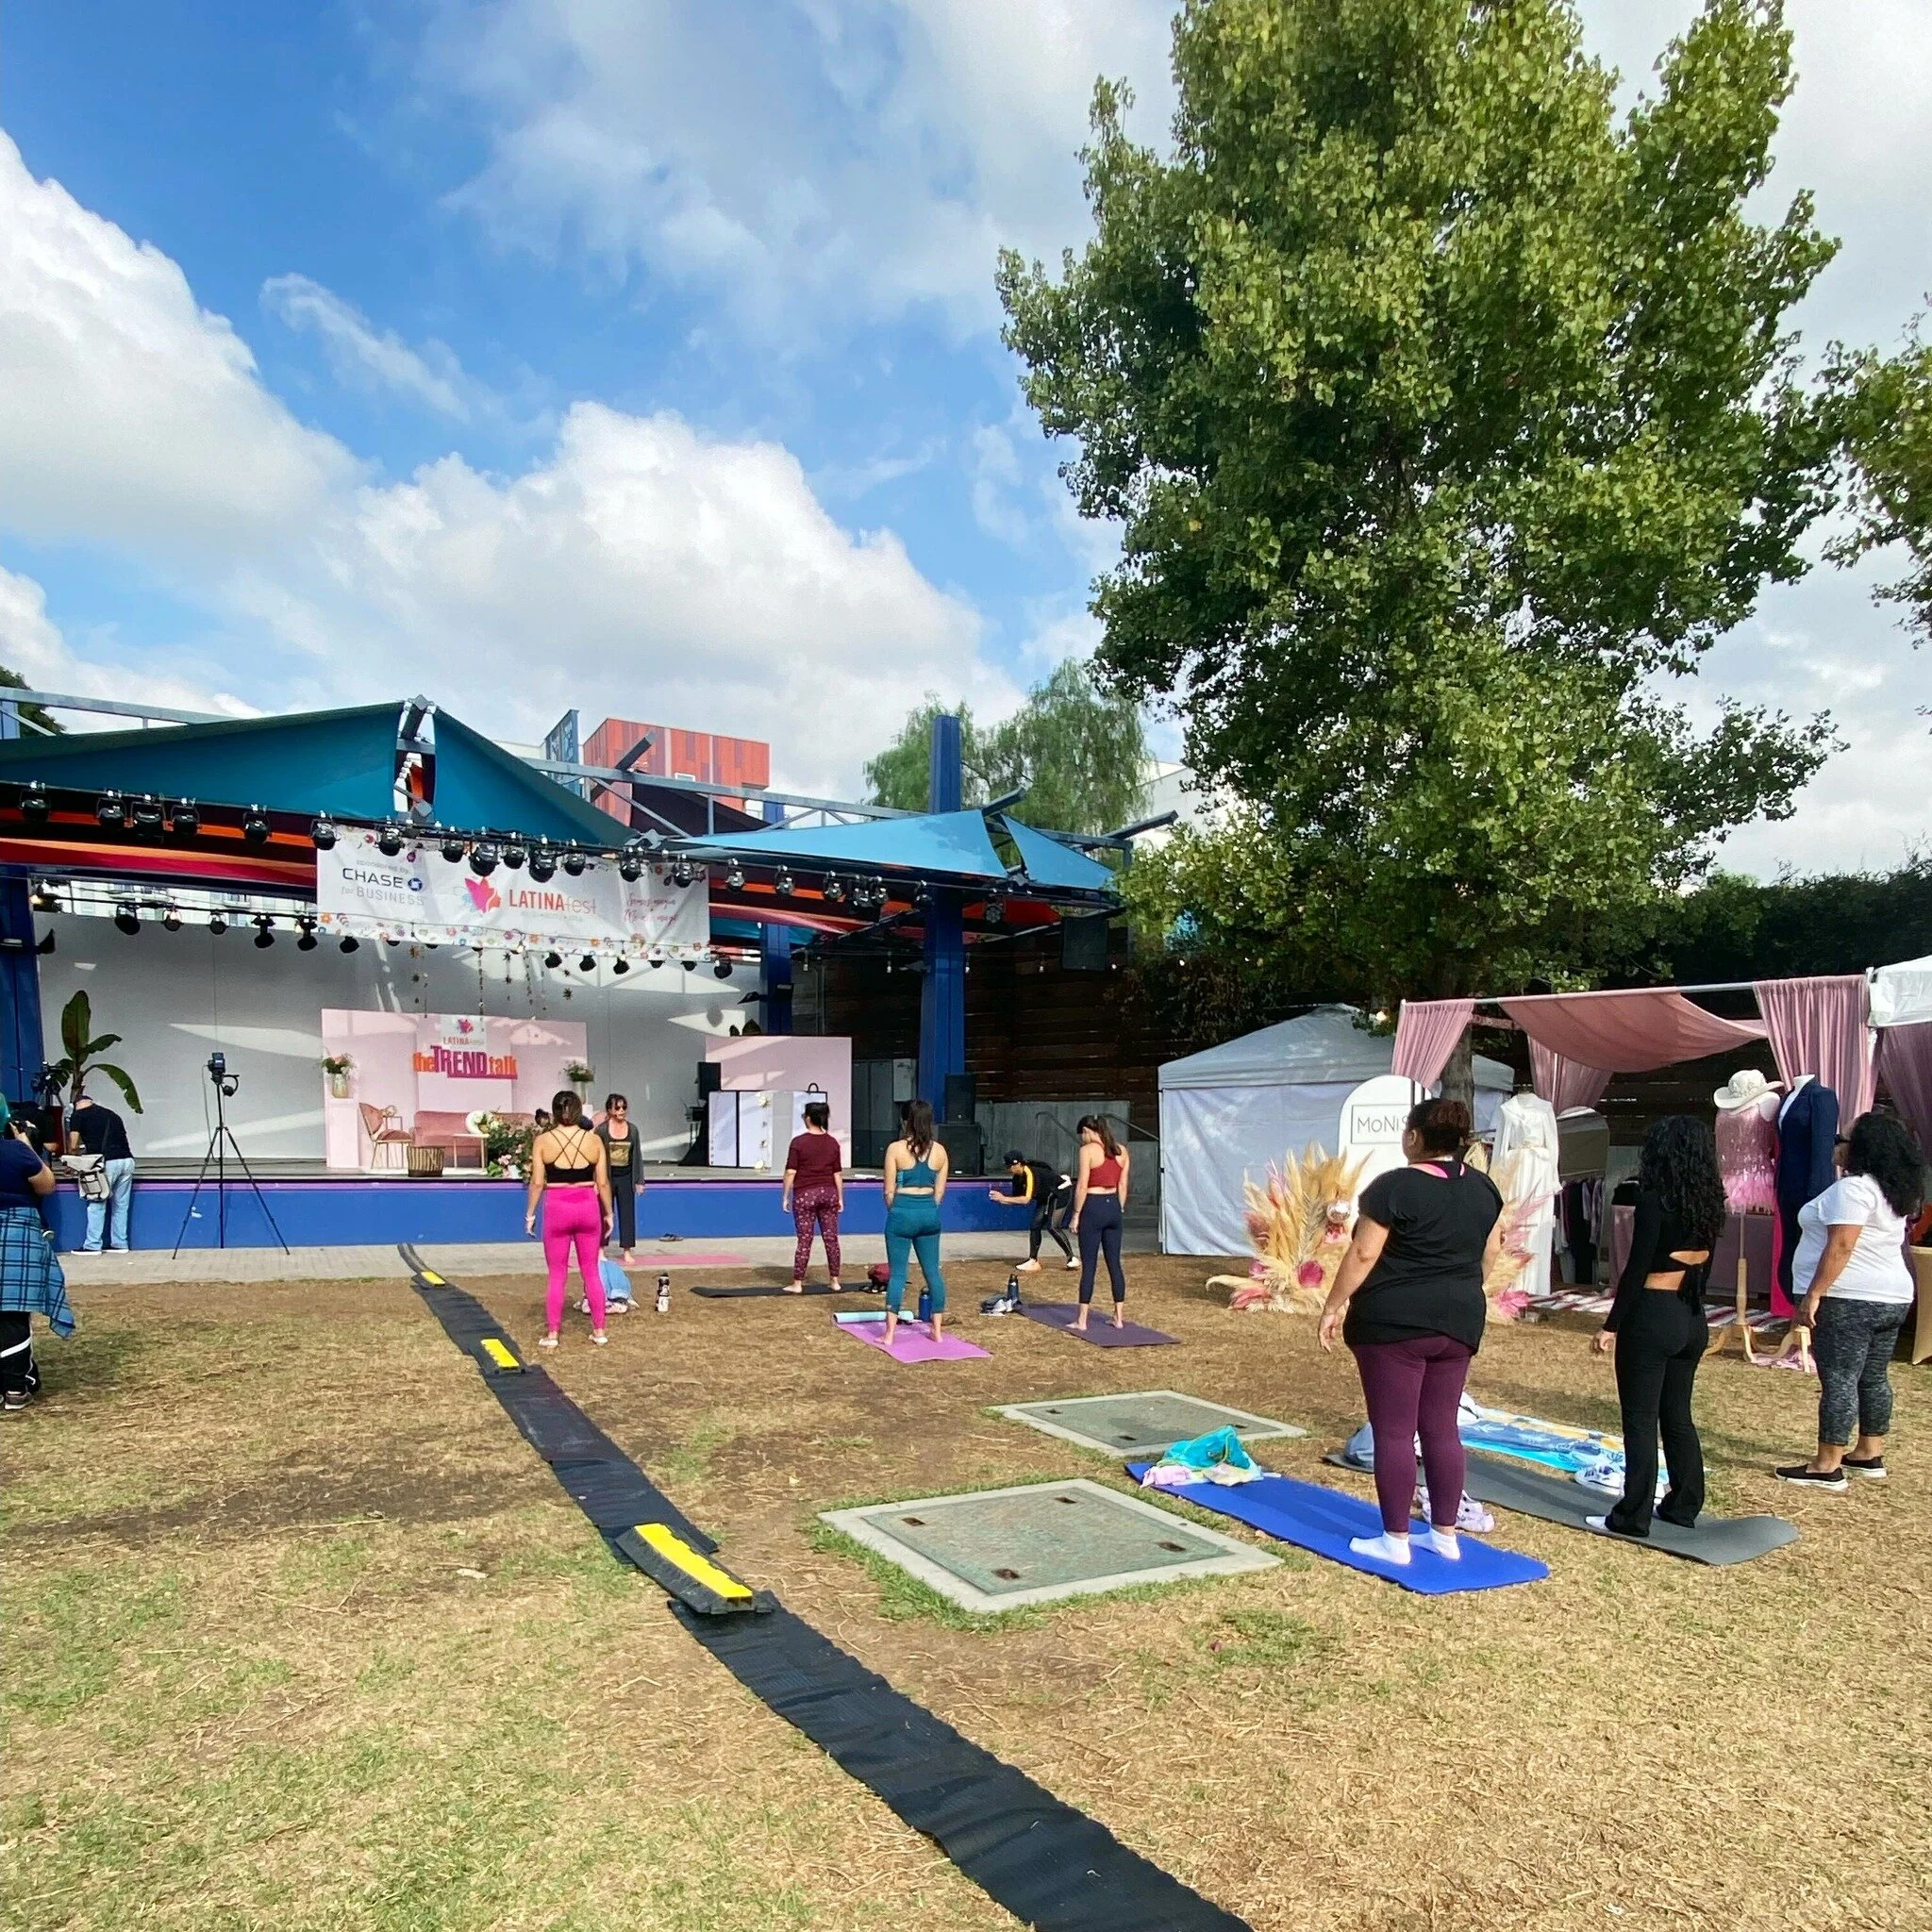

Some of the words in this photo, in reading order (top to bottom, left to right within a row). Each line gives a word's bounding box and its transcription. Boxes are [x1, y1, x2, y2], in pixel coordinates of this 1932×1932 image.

[342, 867, 404, 889] CHASE
[341, 886, 354, 895] for
[357, 886, 425, 906] BUSINESS
[509, 889, 597, 914] LATINAfest
